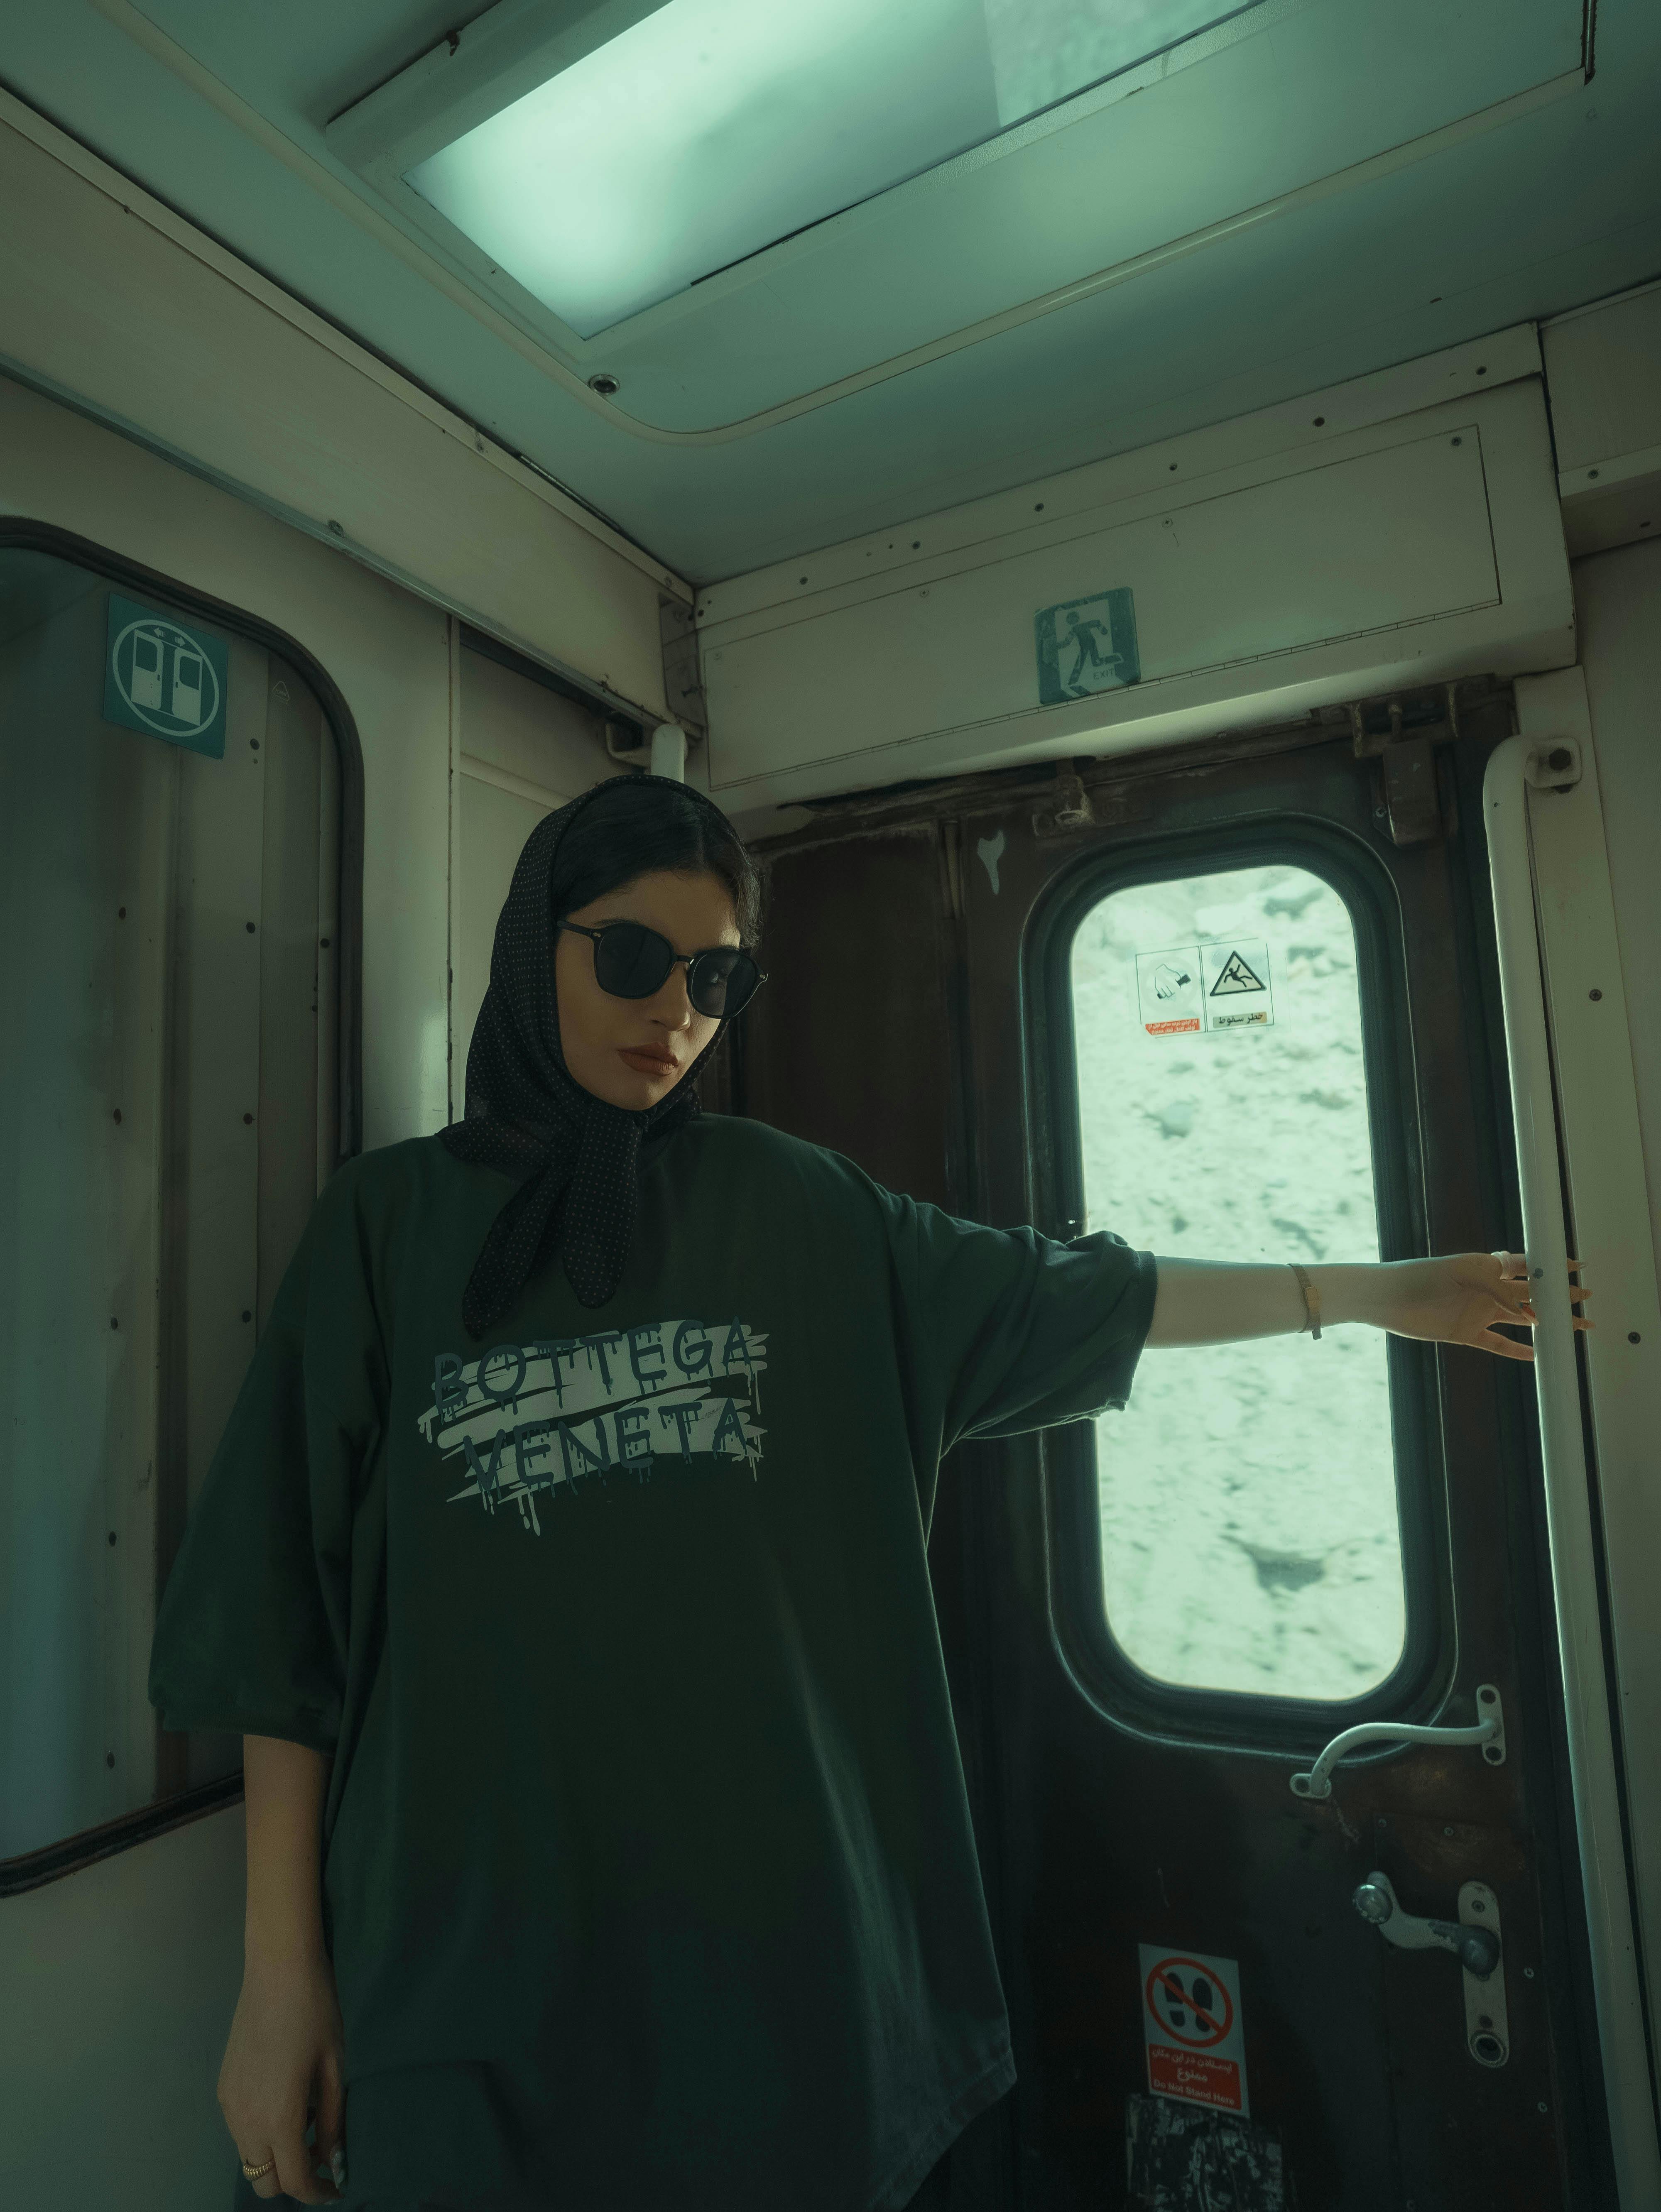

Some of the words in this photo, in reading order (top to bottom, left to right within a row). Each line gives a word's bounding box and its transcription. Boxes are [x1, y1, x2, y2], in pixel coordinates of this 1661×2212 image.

[1093, 668, 1113, 680] EXIT
[1219, 1015, 1244, 1026] سقوط
[1247, 1013, 1263, 1024] خطر
[434, 1316, 753, 1422] BOTTEGA
[463, 1397, 747, 1496] VENETA
[1172, 2053, 1184, 2063] این
[1198, 2059, 1232, 2074] ایستادن
[1177, 2068, 1208, 2082] ممنوع
[1154, 2079, 1166, 2089] Do
[1167, 2082, 1183, 2093] Not
[1186, 2087, 1211, 2099] Stand
[1213, 2092, 1235, 2105] Here
